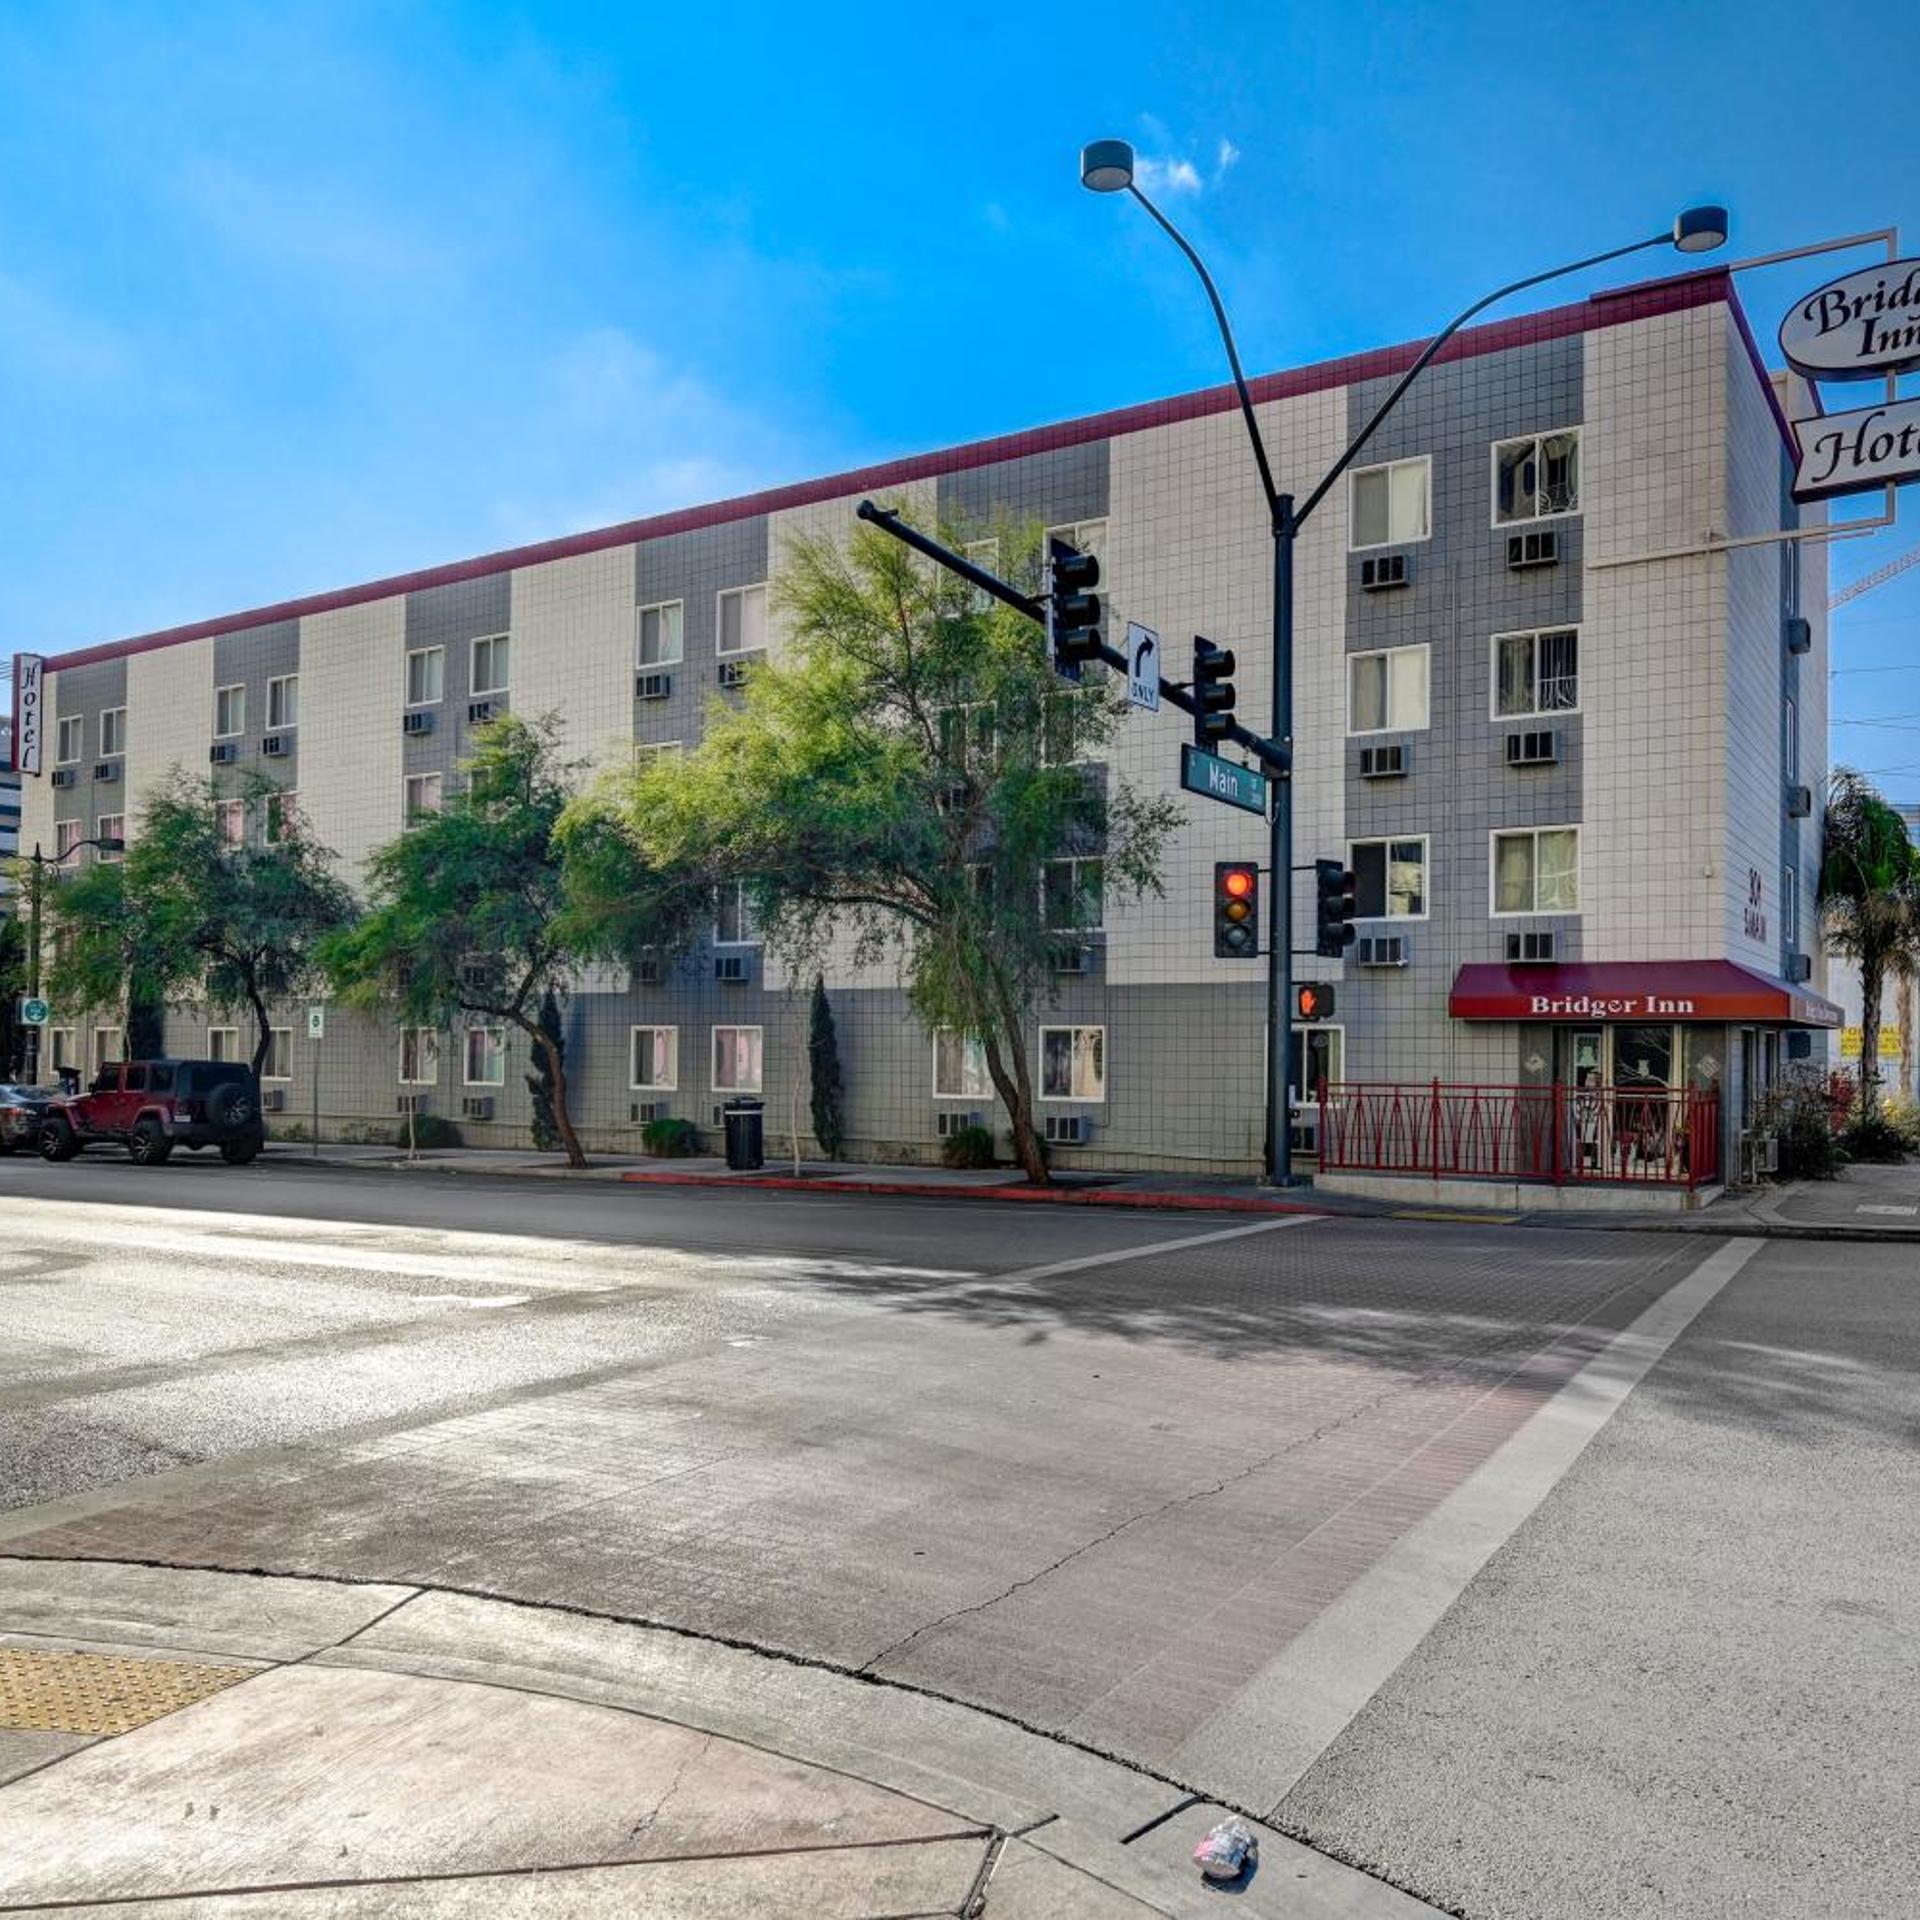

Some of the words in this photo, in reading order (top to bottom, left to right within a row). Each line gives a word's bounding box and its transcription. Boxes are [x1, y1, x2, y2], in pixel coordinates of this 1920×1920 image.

[1811, 410, 1920, 483] Hot
[1132, 682, 1155, 704] ONLY
[20, 661, 41, 769] Hotel
[1209, 761, 1238, 798] Main
[1530, 995, 1638, 1018] Bridger
[1645, 995, 1694, 1013] Inn
